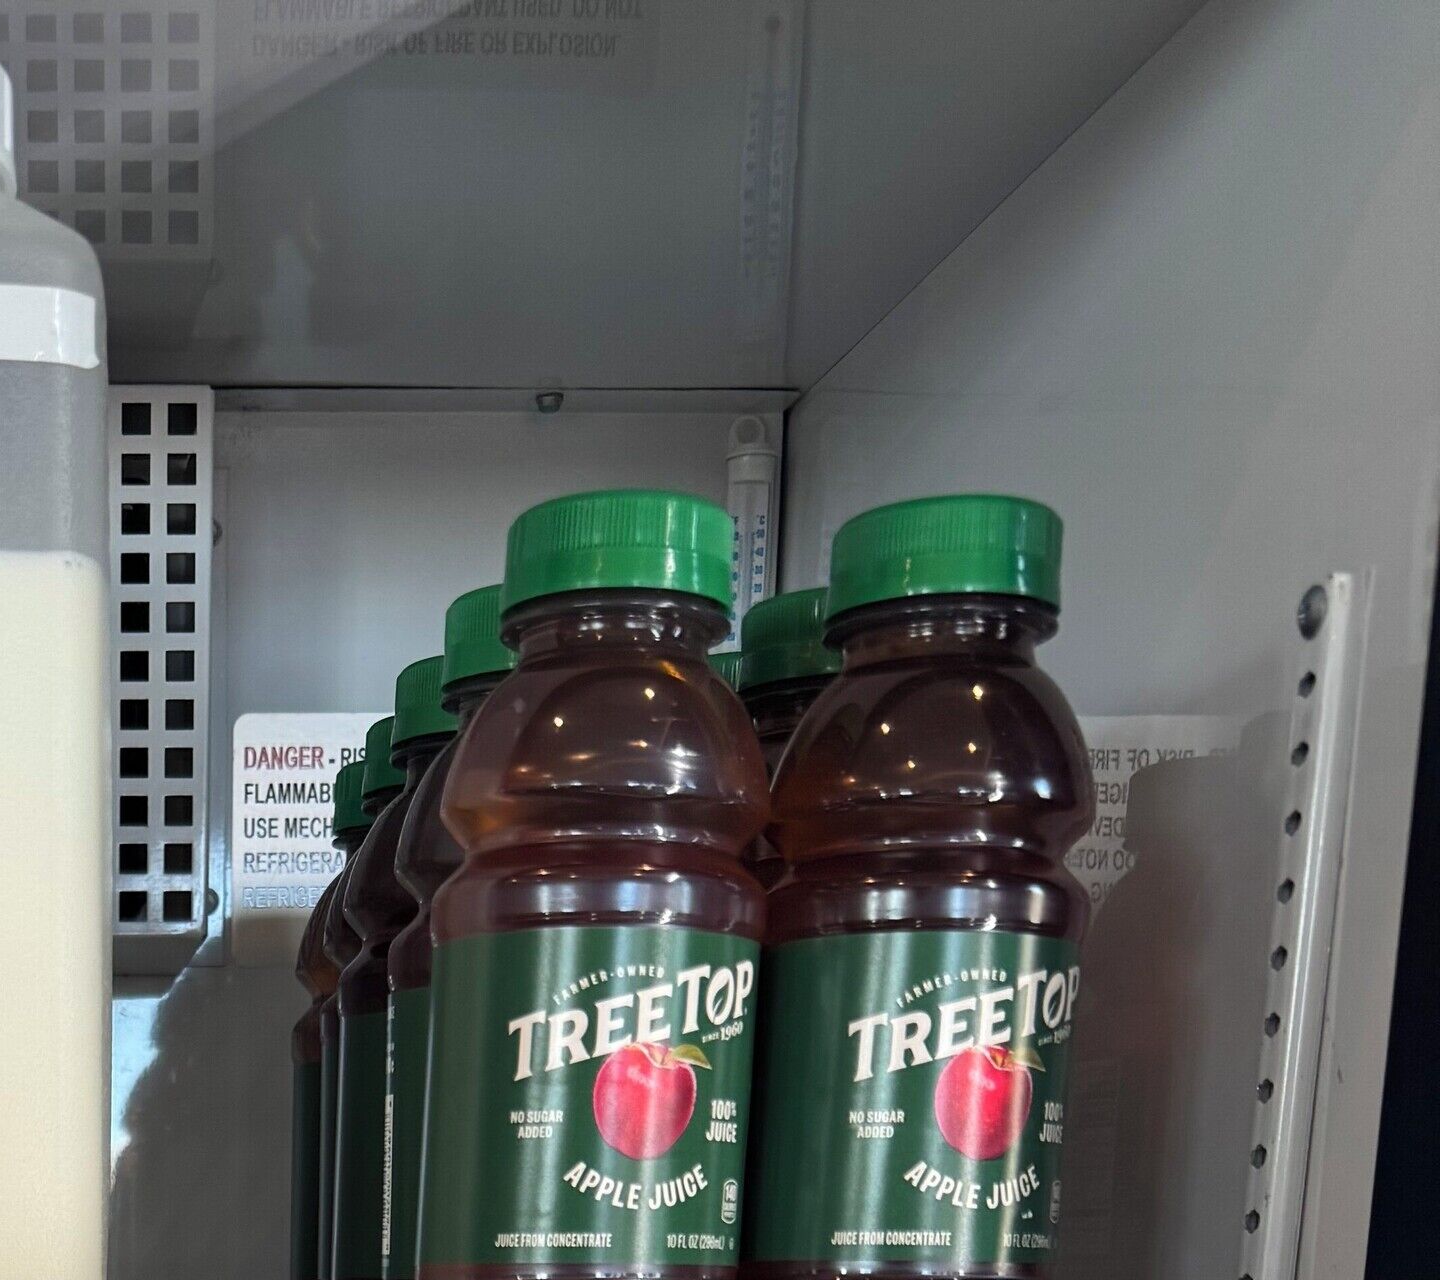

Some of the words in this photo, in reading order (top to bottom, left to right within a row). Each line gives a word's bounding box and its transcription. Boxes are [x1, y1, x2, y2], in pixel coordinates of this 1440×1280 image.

[244, 746, 324, 770] DANGER
[244, 783, 336, 805] FLAMMAB
[244, 818, 279, 839] USE
[284, 818, 334, 839] MECH
[243, 852, 345, 874] REFRIGERA
[510, 1110, 526, 1125] NO
[527, 1109, 564, 1125] SUGAR
[849, 1110, 865, 1125] NO
[867, 1109, 905, 1125] SUGAR
[517, 1126, 554, 1140] ADDED
[705, 1121, 738, 1144] JUICE
[856, 1126, 894, 1140] ADDED
[563, 1161, 640, 1210] APPLE
[648, 1163, 708, 1210] JUICE
[903, 1160, 980, 1210] APPLE
[986, 1165, 1041, 1210] JUICE
[520, 1233, 545, 1248] FROM
[546, 1233, 612, 1248] CONCENTRATE
[831, 1231, 857, 1247] JUICE
[858, 1231, 885, 1247] FROM
[885, 1231, 952, 1248] CONCENTRATE
